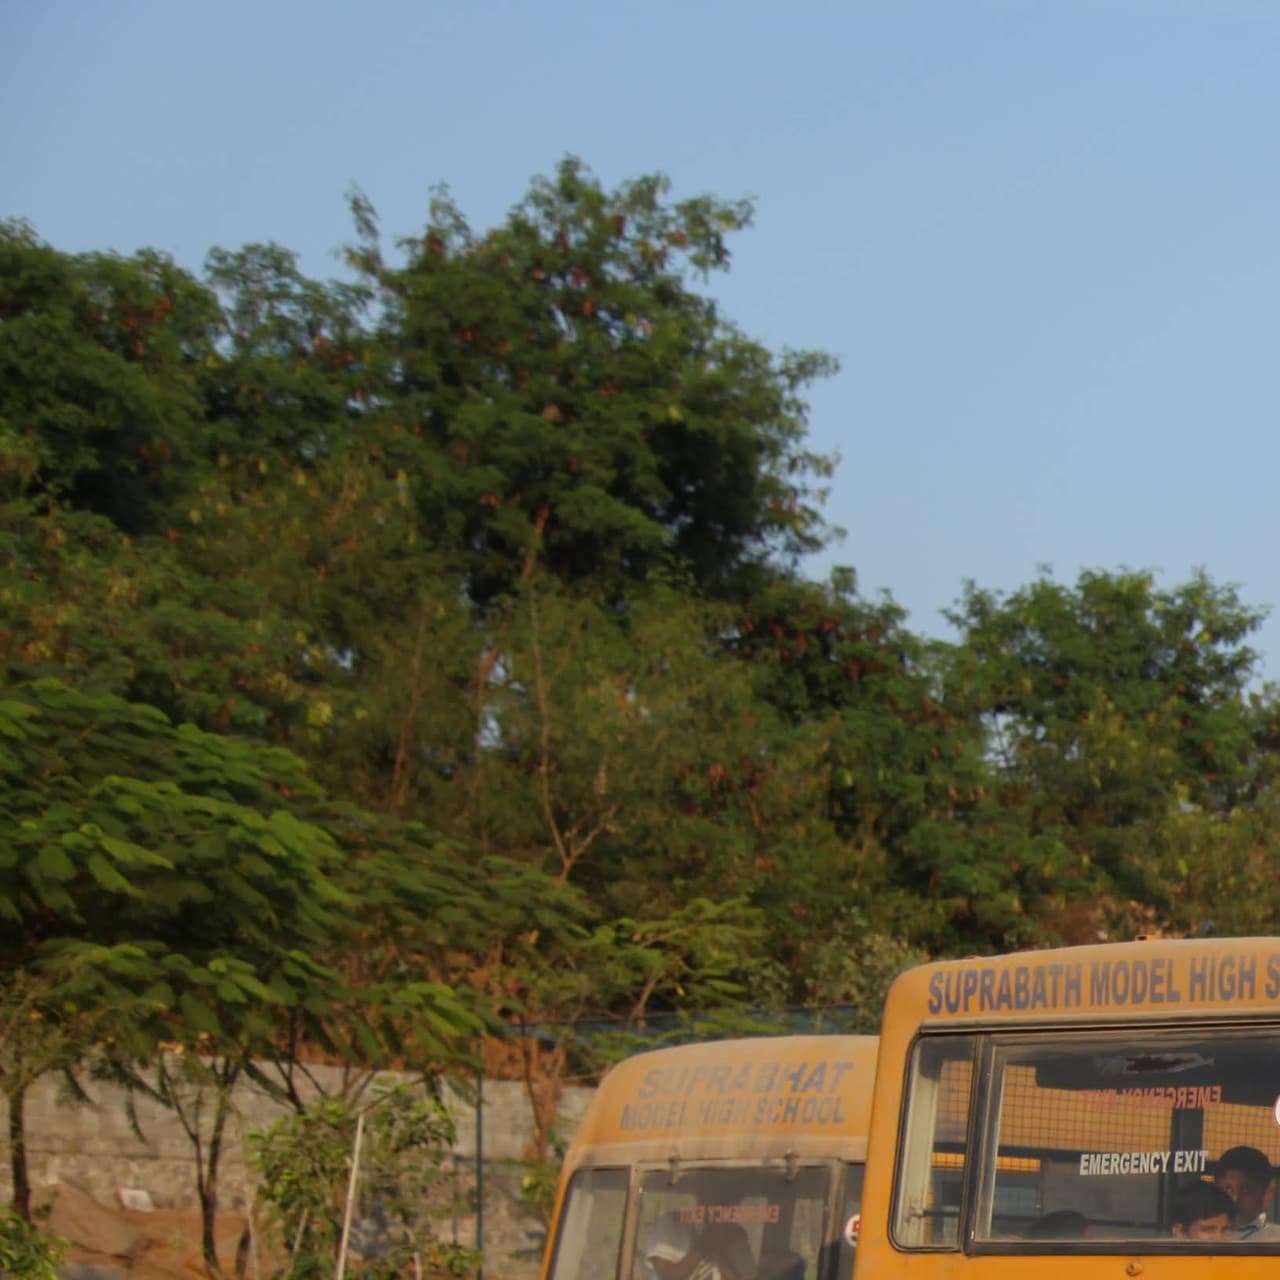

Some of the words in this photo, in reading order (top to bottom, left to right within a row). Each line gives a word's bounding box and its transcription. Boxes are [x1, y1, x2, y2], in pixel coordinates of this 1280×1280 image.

[928, 962, 1082, 1014] SUPRABATH
[1089, 958, 1180, 1005] MODEL
[1190, 953, 1257, 1002] HIGH
[620, 1101, 688, 1131] MODEL
[752, 1095, 846, 1126] SCHOOL
[1080, 1152, 1170, 1176] EMERGENCY
[1173, 1150, 1208, 1173] EXIT
